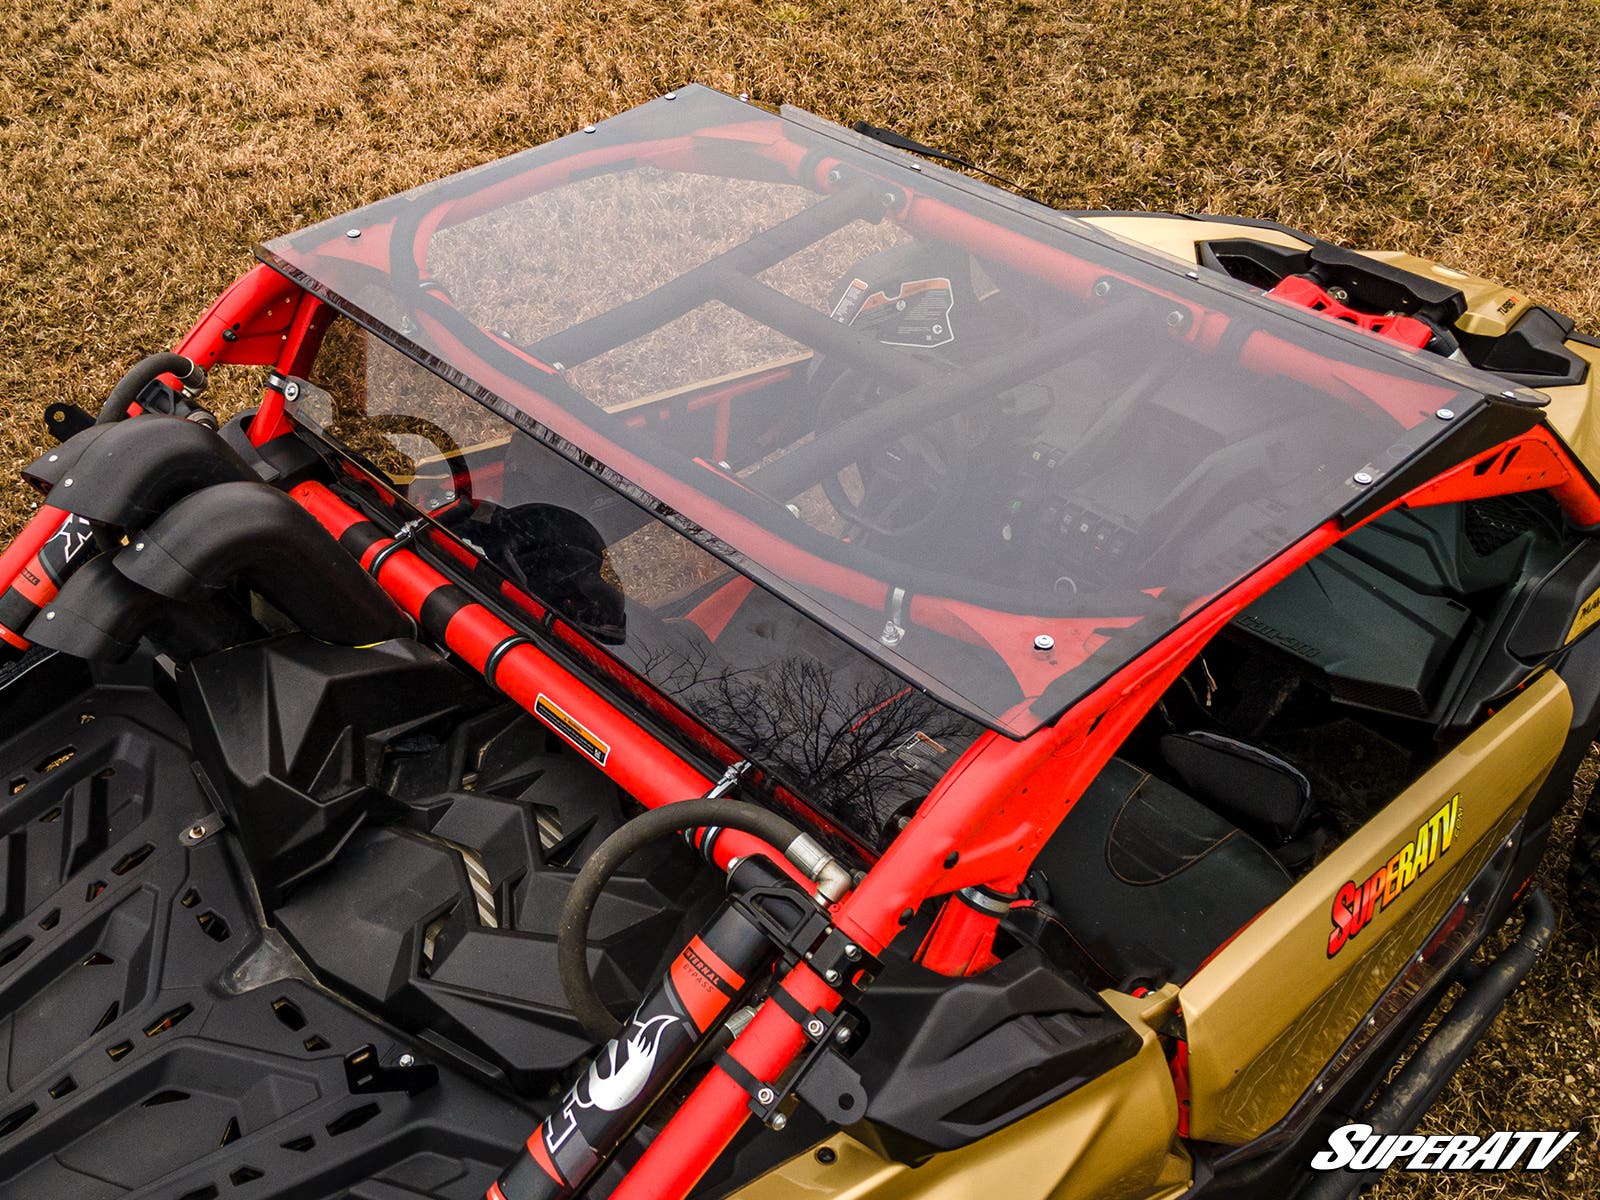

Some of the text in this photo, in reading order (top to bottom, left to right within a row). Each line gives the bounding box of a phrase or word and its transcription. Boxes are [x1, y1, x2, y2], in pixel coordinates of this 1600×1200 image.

[1327, 793, 1459, 958] SUPERATV
[683, 947, 720, 986] NTERNAL
[683, 963, 714, 992] BYPASS
